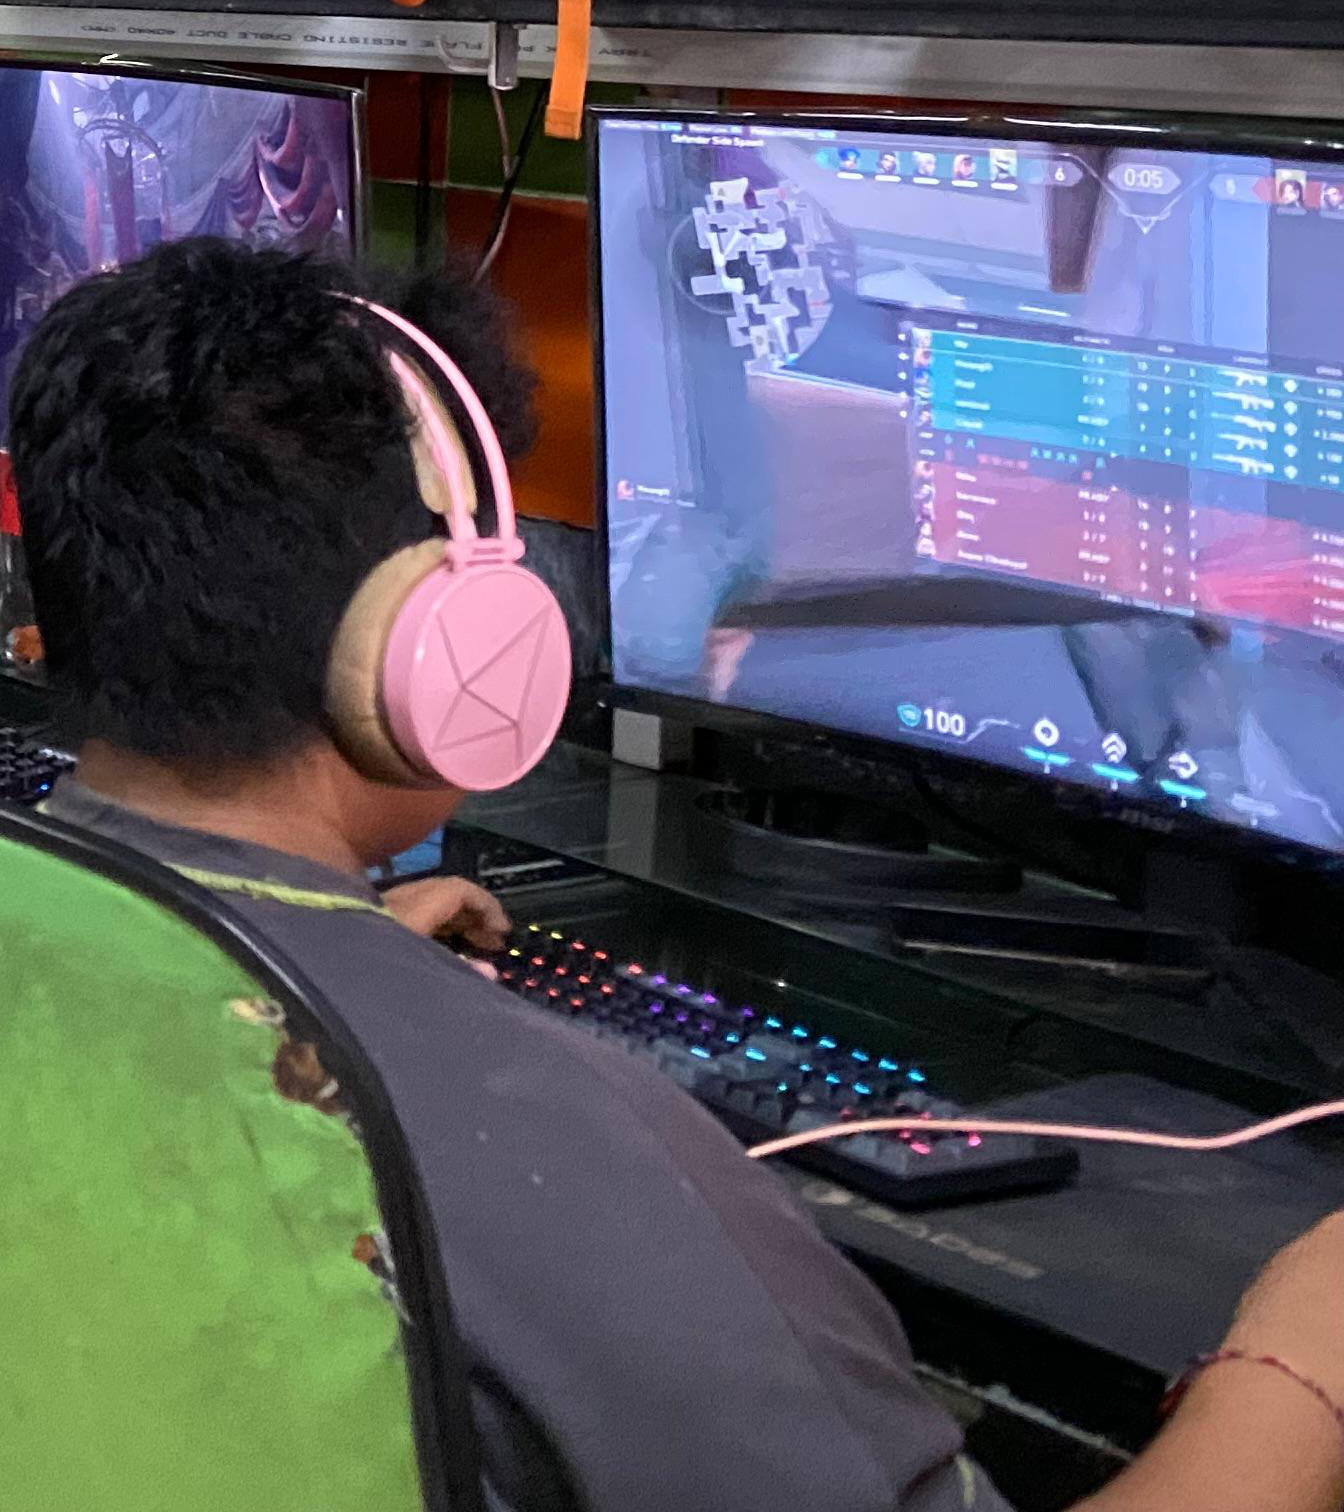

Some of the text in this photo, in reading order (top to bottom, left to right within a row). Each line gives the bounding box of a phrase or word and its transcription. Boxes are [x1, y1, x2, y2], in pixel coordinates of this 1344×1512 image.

[186, 29, 228, 39] DUCT
[238, 31, 292, 42] CABLE
[303, 35, 408, 49] RESISTING
[420, 38, 483, 51] FLAE
[1123, 168, 1163, 189] 0:05
[924, 707, 965, 737] 100
